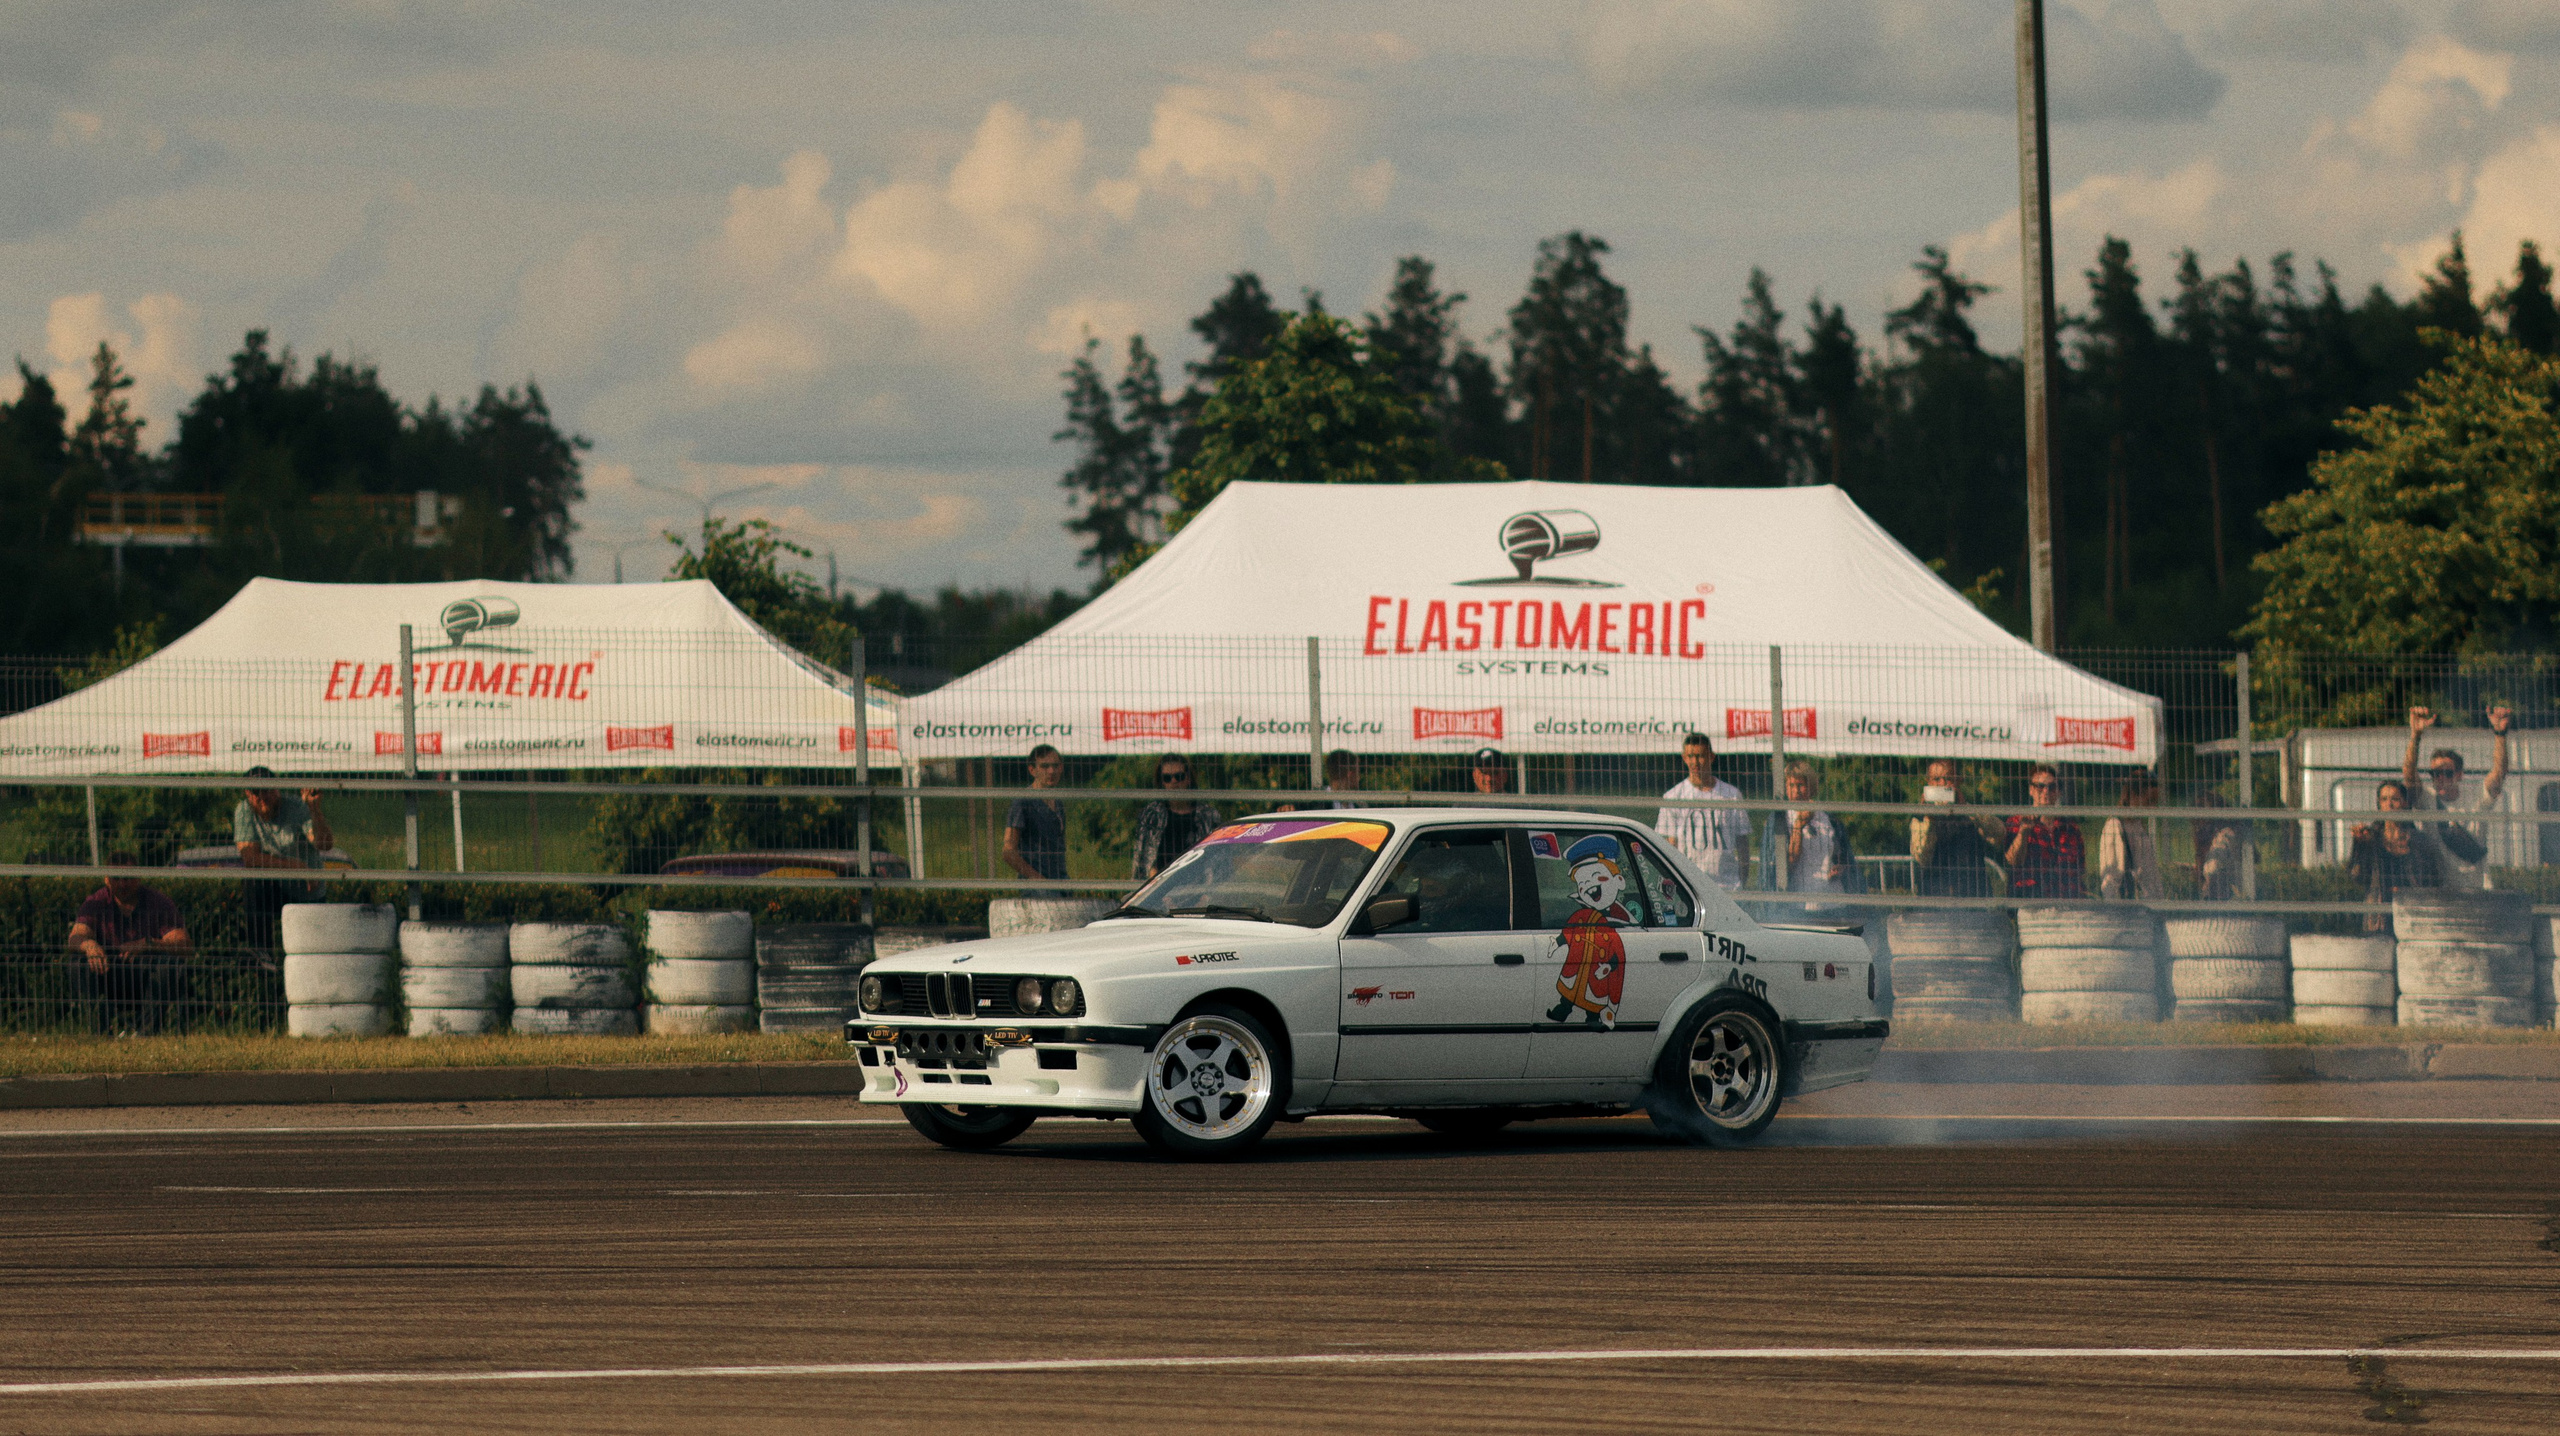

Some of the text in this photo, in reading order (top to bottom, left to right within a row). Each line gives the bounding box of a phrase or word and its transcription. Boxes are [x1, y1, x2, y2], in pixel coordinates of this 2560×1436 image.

[1364, 596, 1705, 659] ELASTOMERIC
[1456, 660, 1610, 676] SYSTEMS
[913, 719, 1072, 738] elastomeric.ru
[1421, 711, 1495, 735] ELASTOMERIC
[1534, 717, 1694, 735] elastomeric.ru
[1734, 711, 1808, 735] ELASTOERIC
[1847, 716, 2011, 740] elastomeric.ru
[696, 732, 817, 747] elastomeric.ru
[2057, 721, 2127, 745] LASTOMERIC
[231, 737, 352, 752] elastomeric.ru
[464, 736, 585, 750] elastomeric.ru
